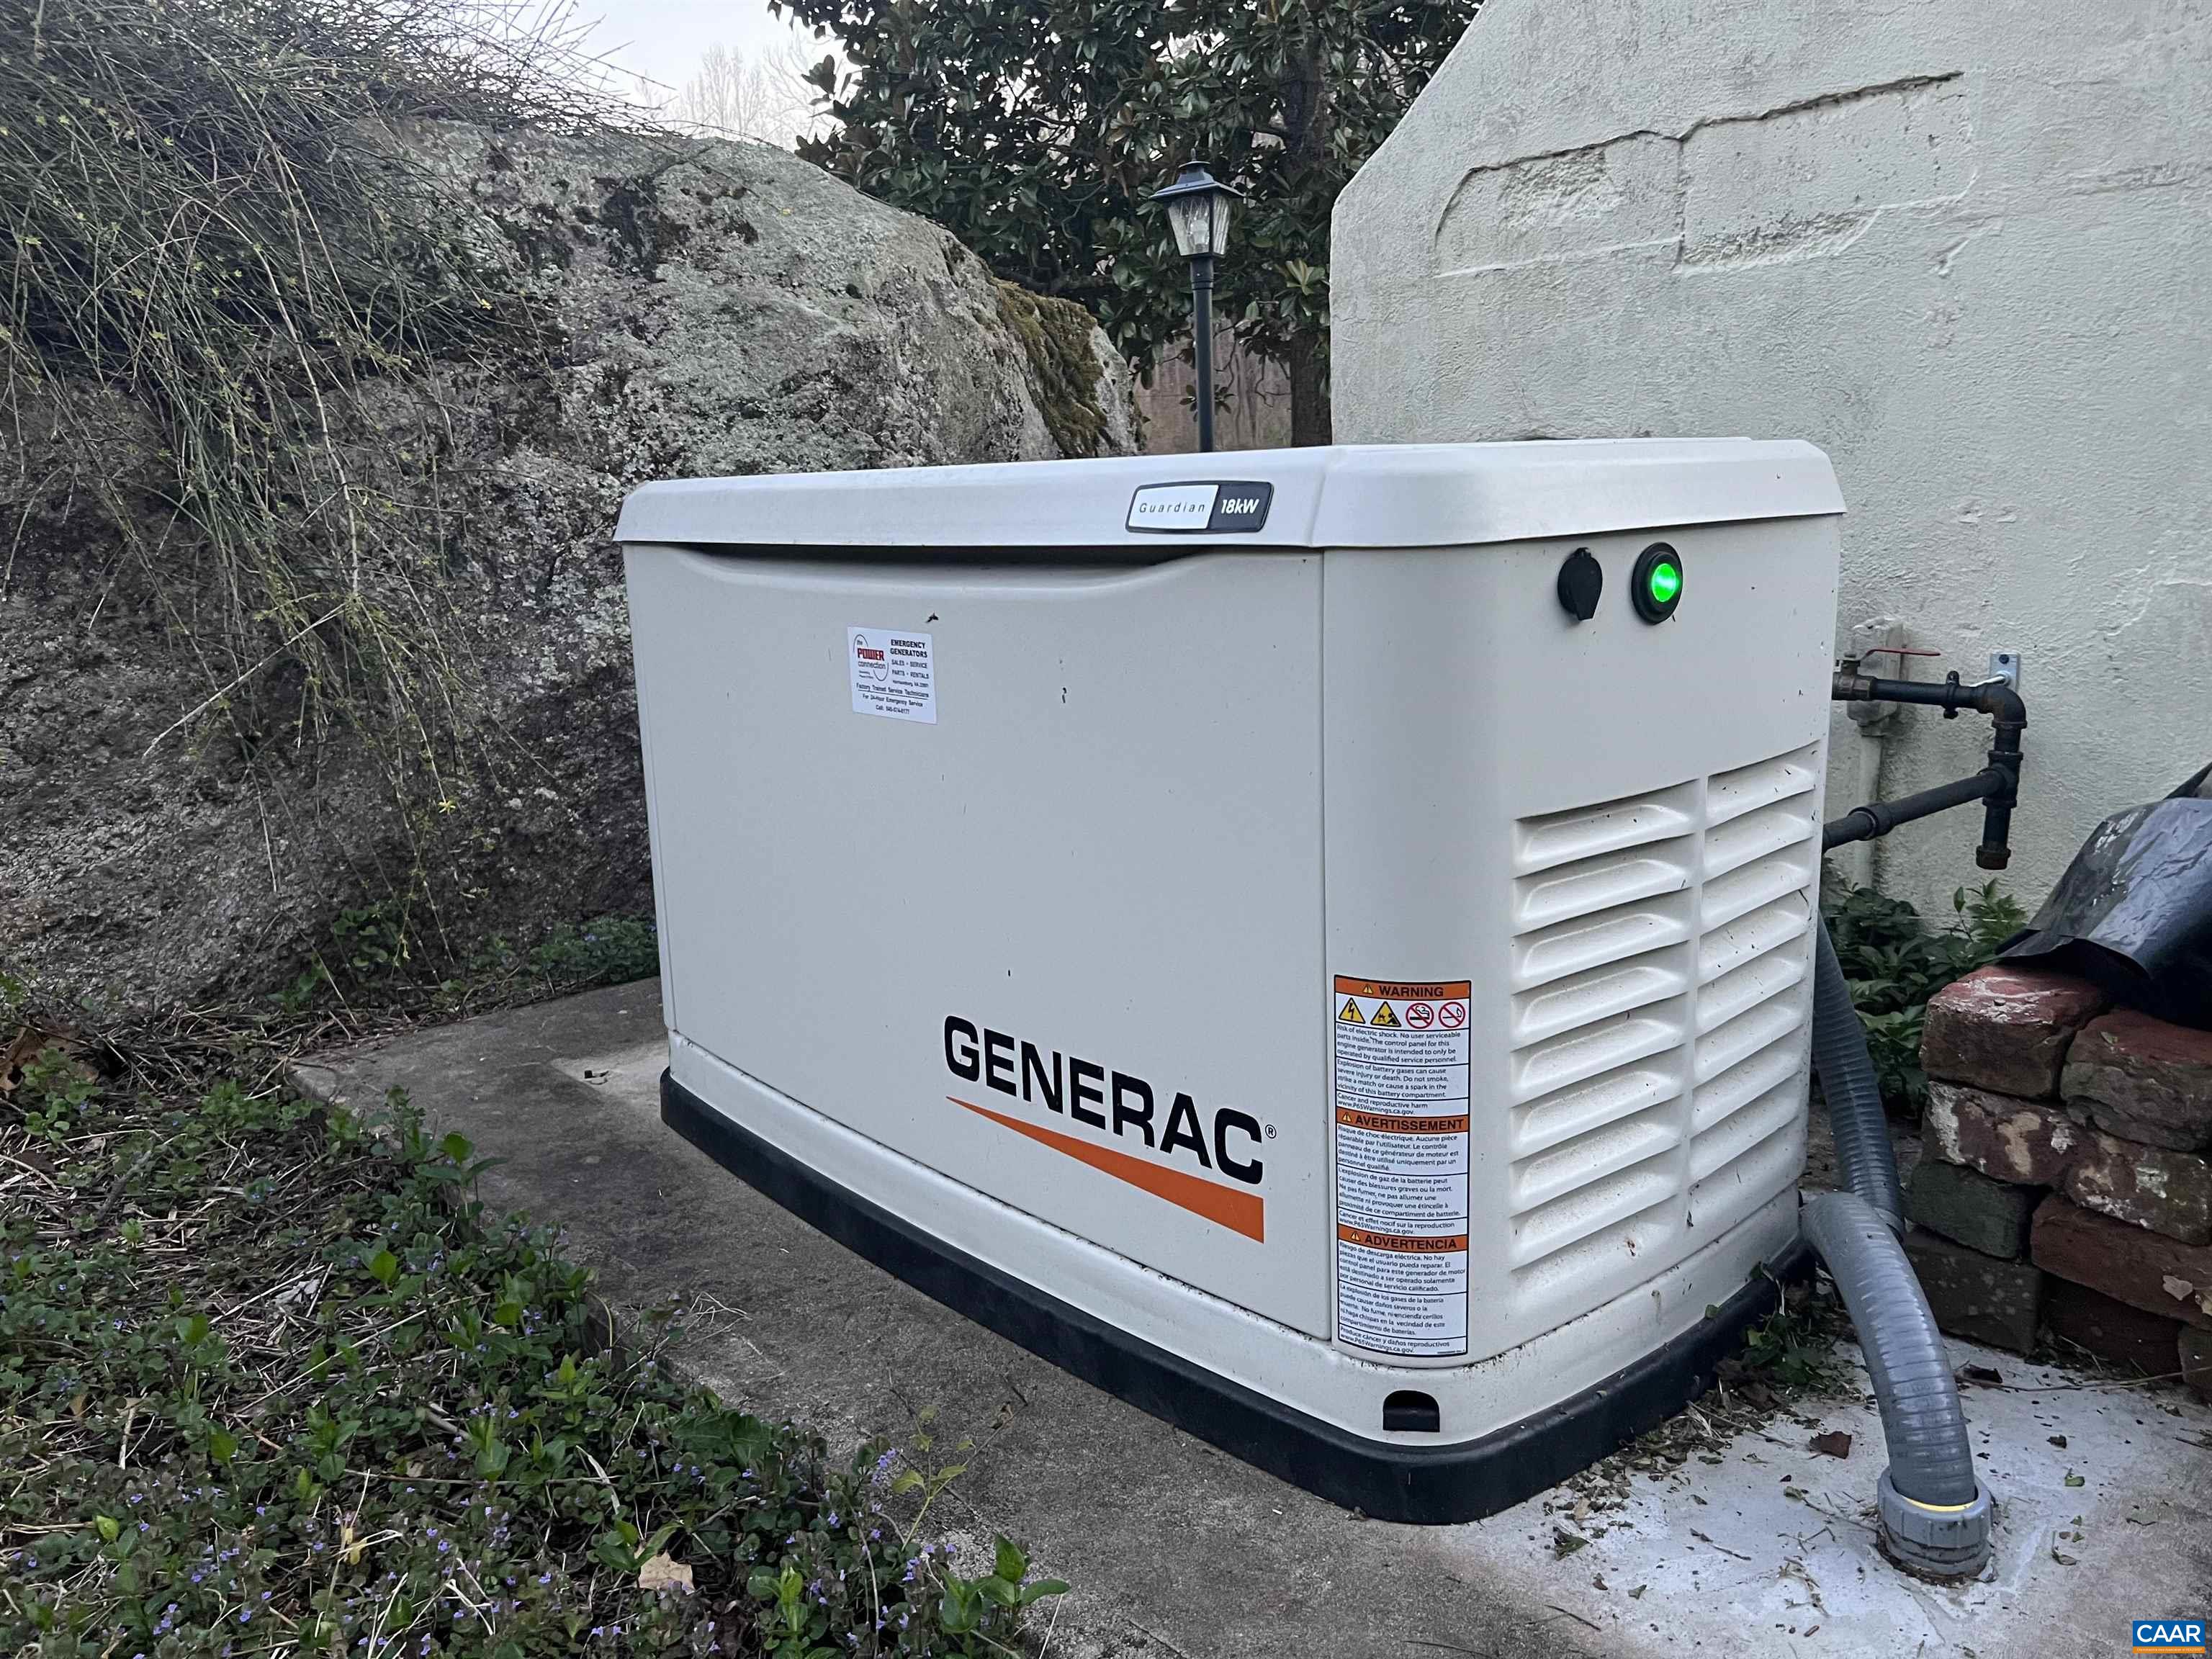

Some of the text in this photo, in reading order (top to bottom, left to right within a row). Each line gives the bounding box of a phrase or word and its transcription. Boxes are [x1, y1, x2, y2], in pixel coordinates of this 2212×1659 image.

[1139, 498, 1260, 514] Guardian 18kW
[891, 639, 926, 649] EMERGENCY
[857, 647, 885, 661] POWER
[890, 648, 927, 658] GENERATORS
[858, 661, 886, 670] connection
[886, 697, 907, 706] Emergency
[1379, 985, 1444, 997] WARNING
[1337, 1058, 1364, 1069] Explosion
[1356, 1071, 1373, 1079] injury
[1377, 1089, 1401, 1098] battery
[944, 1015, 1264, 1184] GENERAC
[1337, 1092, 1356, 1101] Cancer
[1370, 1100, 1409, 1108] reproductive
[1355, 1115, 1464, 1130] AVERTISSEMENT
[1369, 1182, 1397, 1191] blessures
[1372, 1200, 1403, 1208] provoquer
[1364, 1235, 1457, 1249] ADVERTENCIA
[1367, 1249, 1393, 1259] descarga
